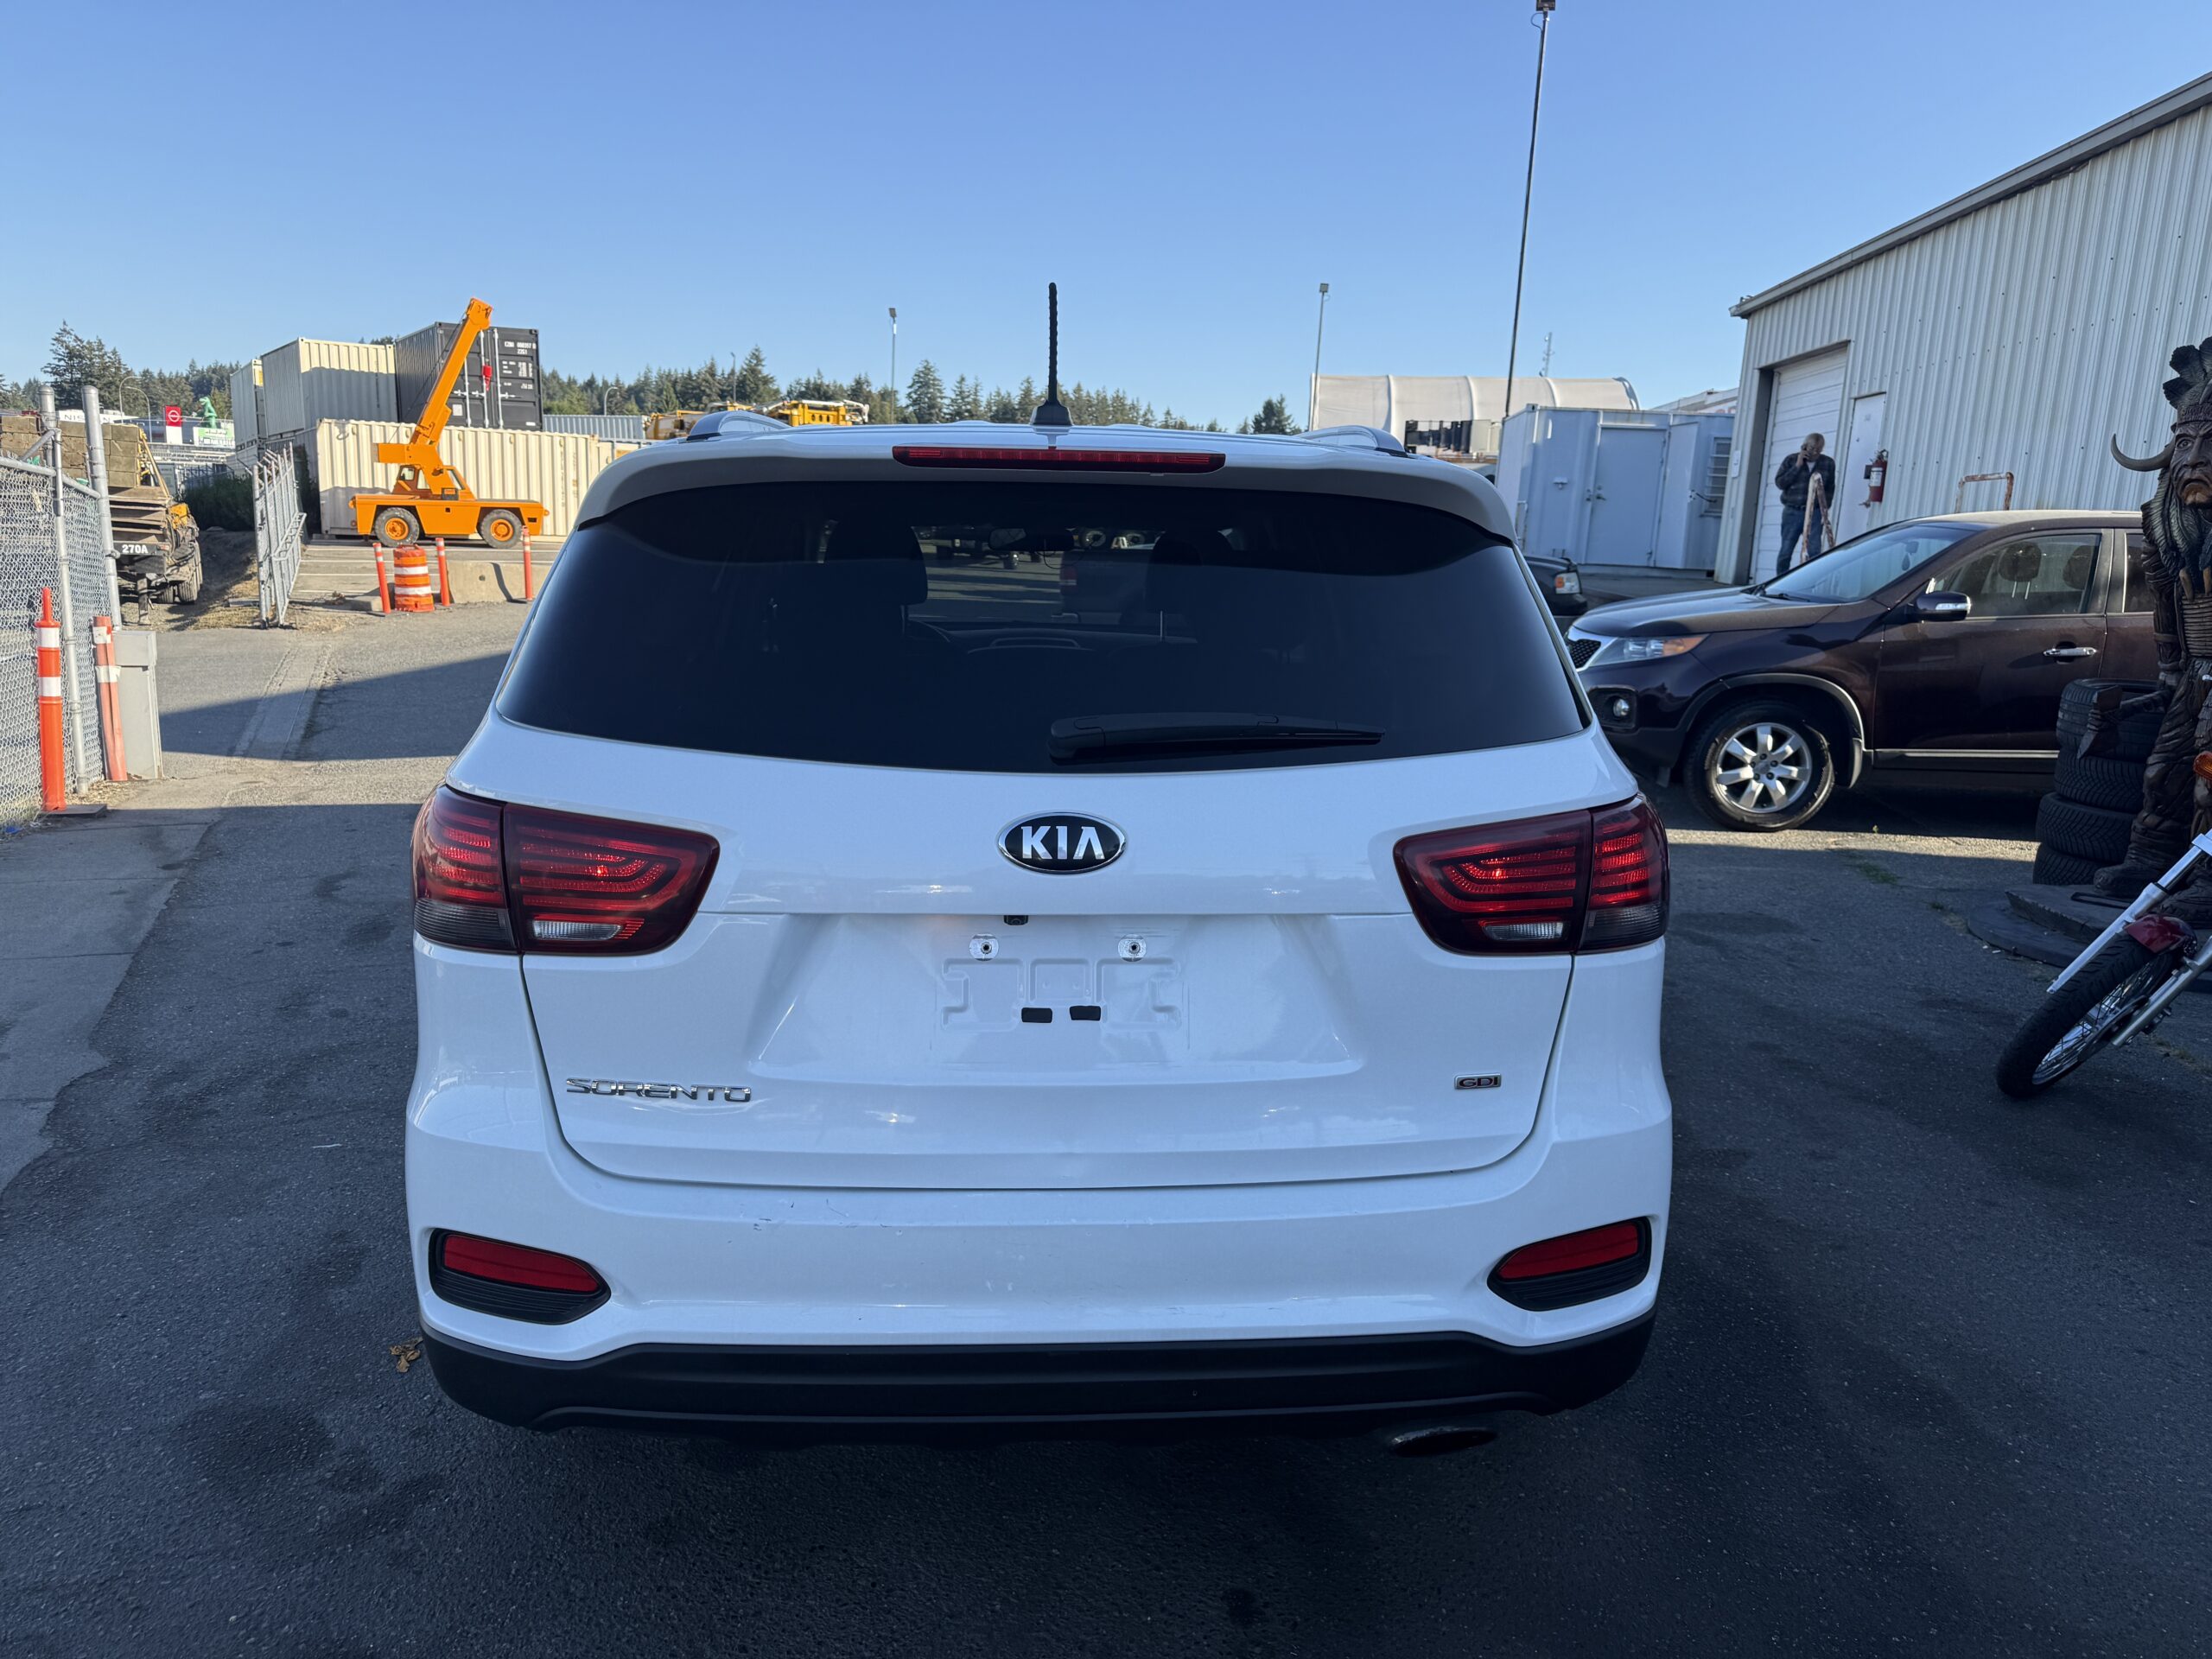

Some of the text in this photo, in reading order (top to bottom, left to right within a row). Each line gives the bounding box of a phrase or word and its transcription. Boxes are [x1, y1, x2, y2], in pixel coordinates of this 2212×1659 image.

[122, 544, 149, 553] 270A
[1021, 825, 1105, 860] KIA
[566, 1077, 751, 1102] SORENTO
[1459, 1076, 1498, 1087] GDI
